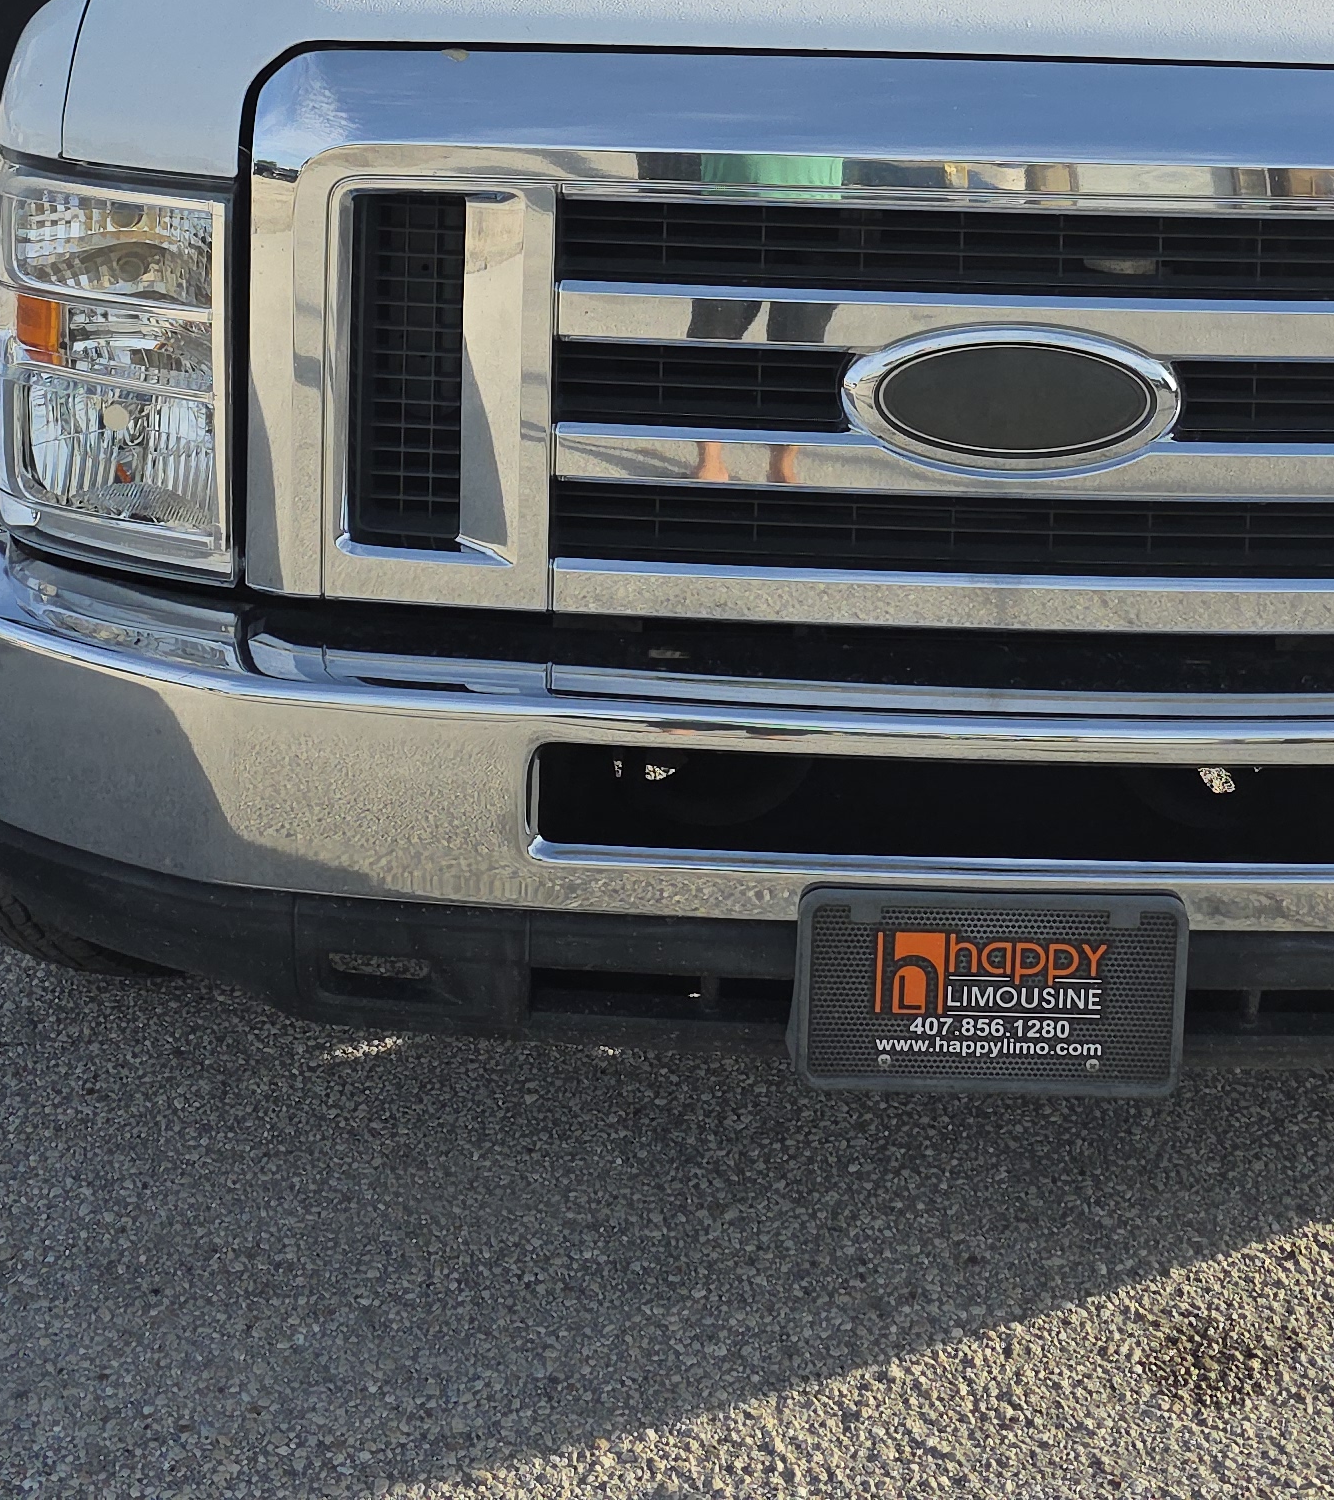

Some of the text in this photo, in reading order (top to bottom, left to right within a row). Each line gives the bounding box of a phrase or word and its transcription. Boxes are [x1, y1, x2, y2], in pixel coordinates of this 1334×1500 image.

[946, 985, 1103, 1011] LIMOUSINE
[909, 1016, 1071, 1040] 407.856.1280
[875, 1036, 1103, 1058] www.happylimo.com
